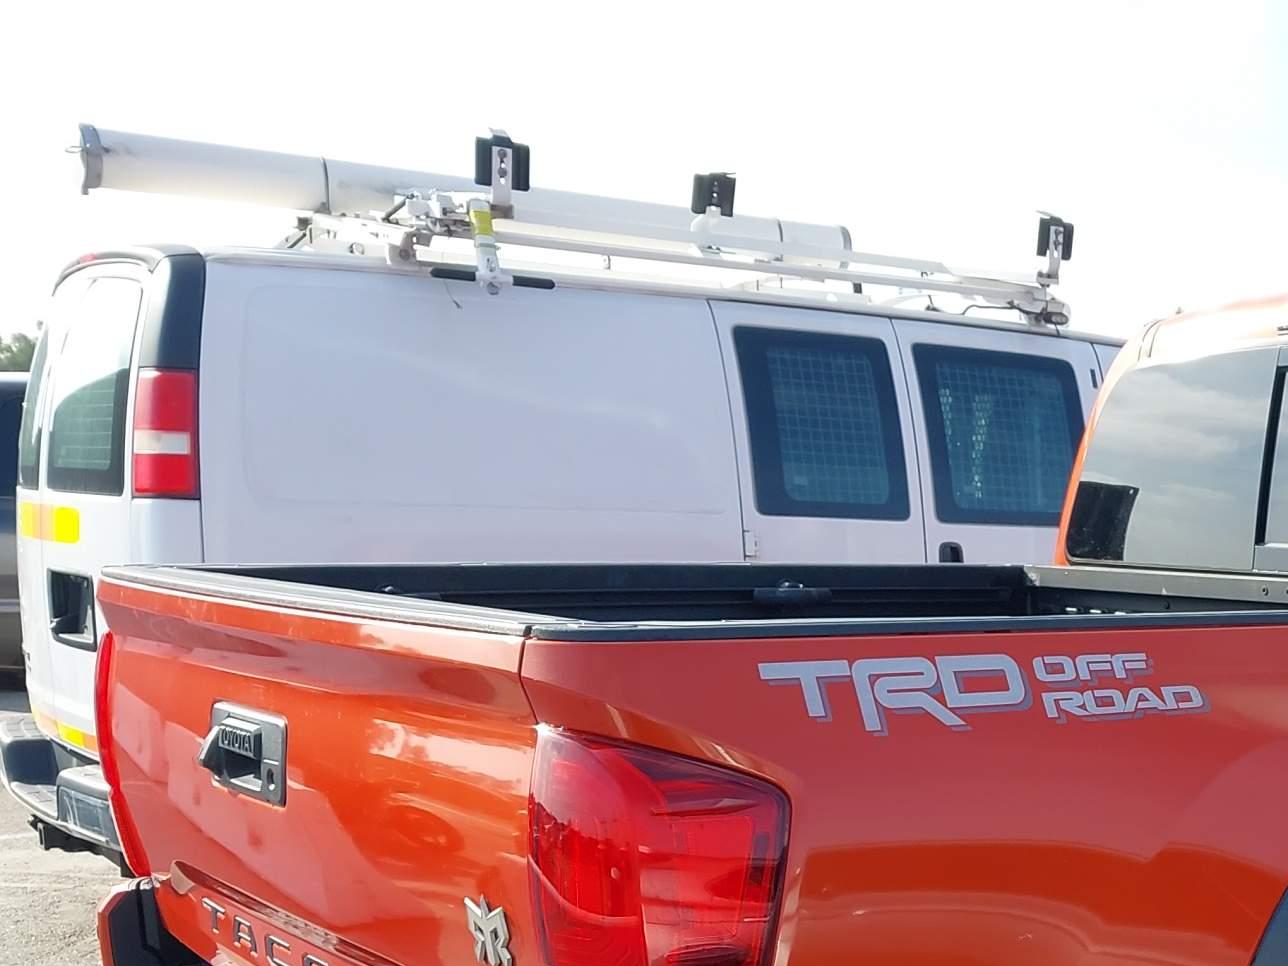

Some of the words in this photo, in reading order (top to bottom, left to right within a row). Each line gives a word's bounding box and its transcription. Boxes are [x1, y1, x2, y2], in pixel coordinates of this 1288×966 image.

[757, 653, 1030, 735] TRD
[1032, 652, 1150, 684] OFF
[1041, 685, 1208, 721] ROAD
